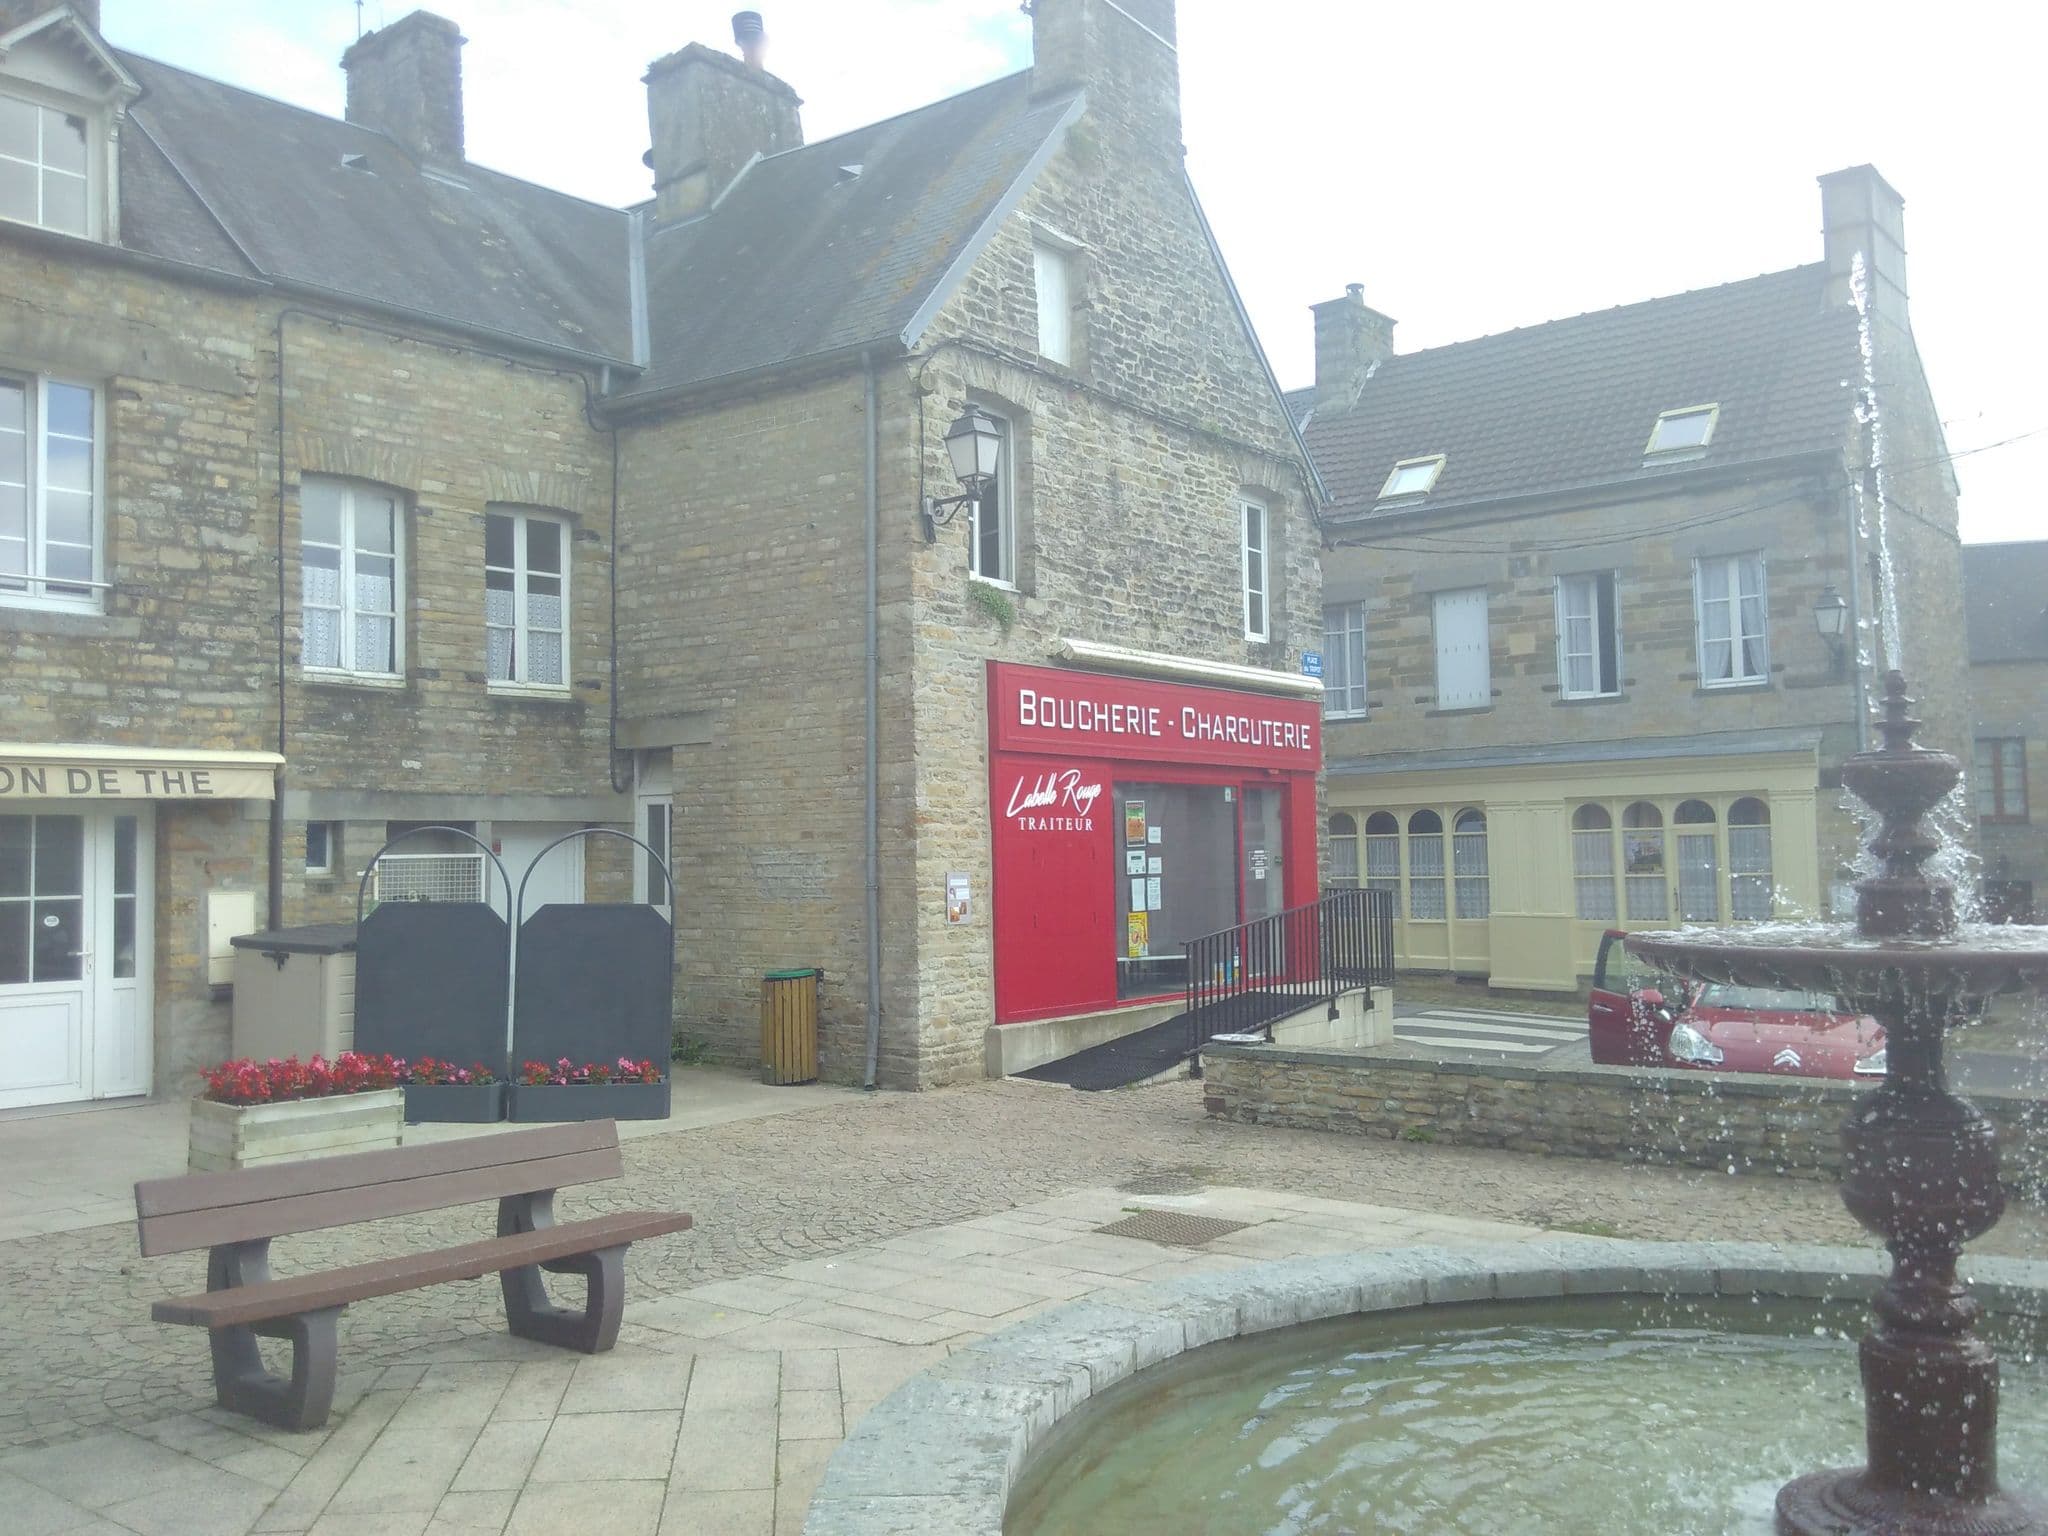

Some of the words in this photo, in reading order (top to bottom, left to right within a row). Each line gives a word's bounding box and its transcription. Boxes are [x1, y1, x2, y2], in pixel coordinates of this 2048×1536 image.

[1019, 689, 1161, 737] BOUCHERIE
[1181, 706, 1311, 750] CHARCUTERIE
[66, 768, 121, 795] DE
[135, 769, 214, 795] THE
[1006, 772, 1058, 818] Labelle
[1058, 769, 1102, 817] Rouge
[1018, 817, 1093, 831] TRAITEUR
